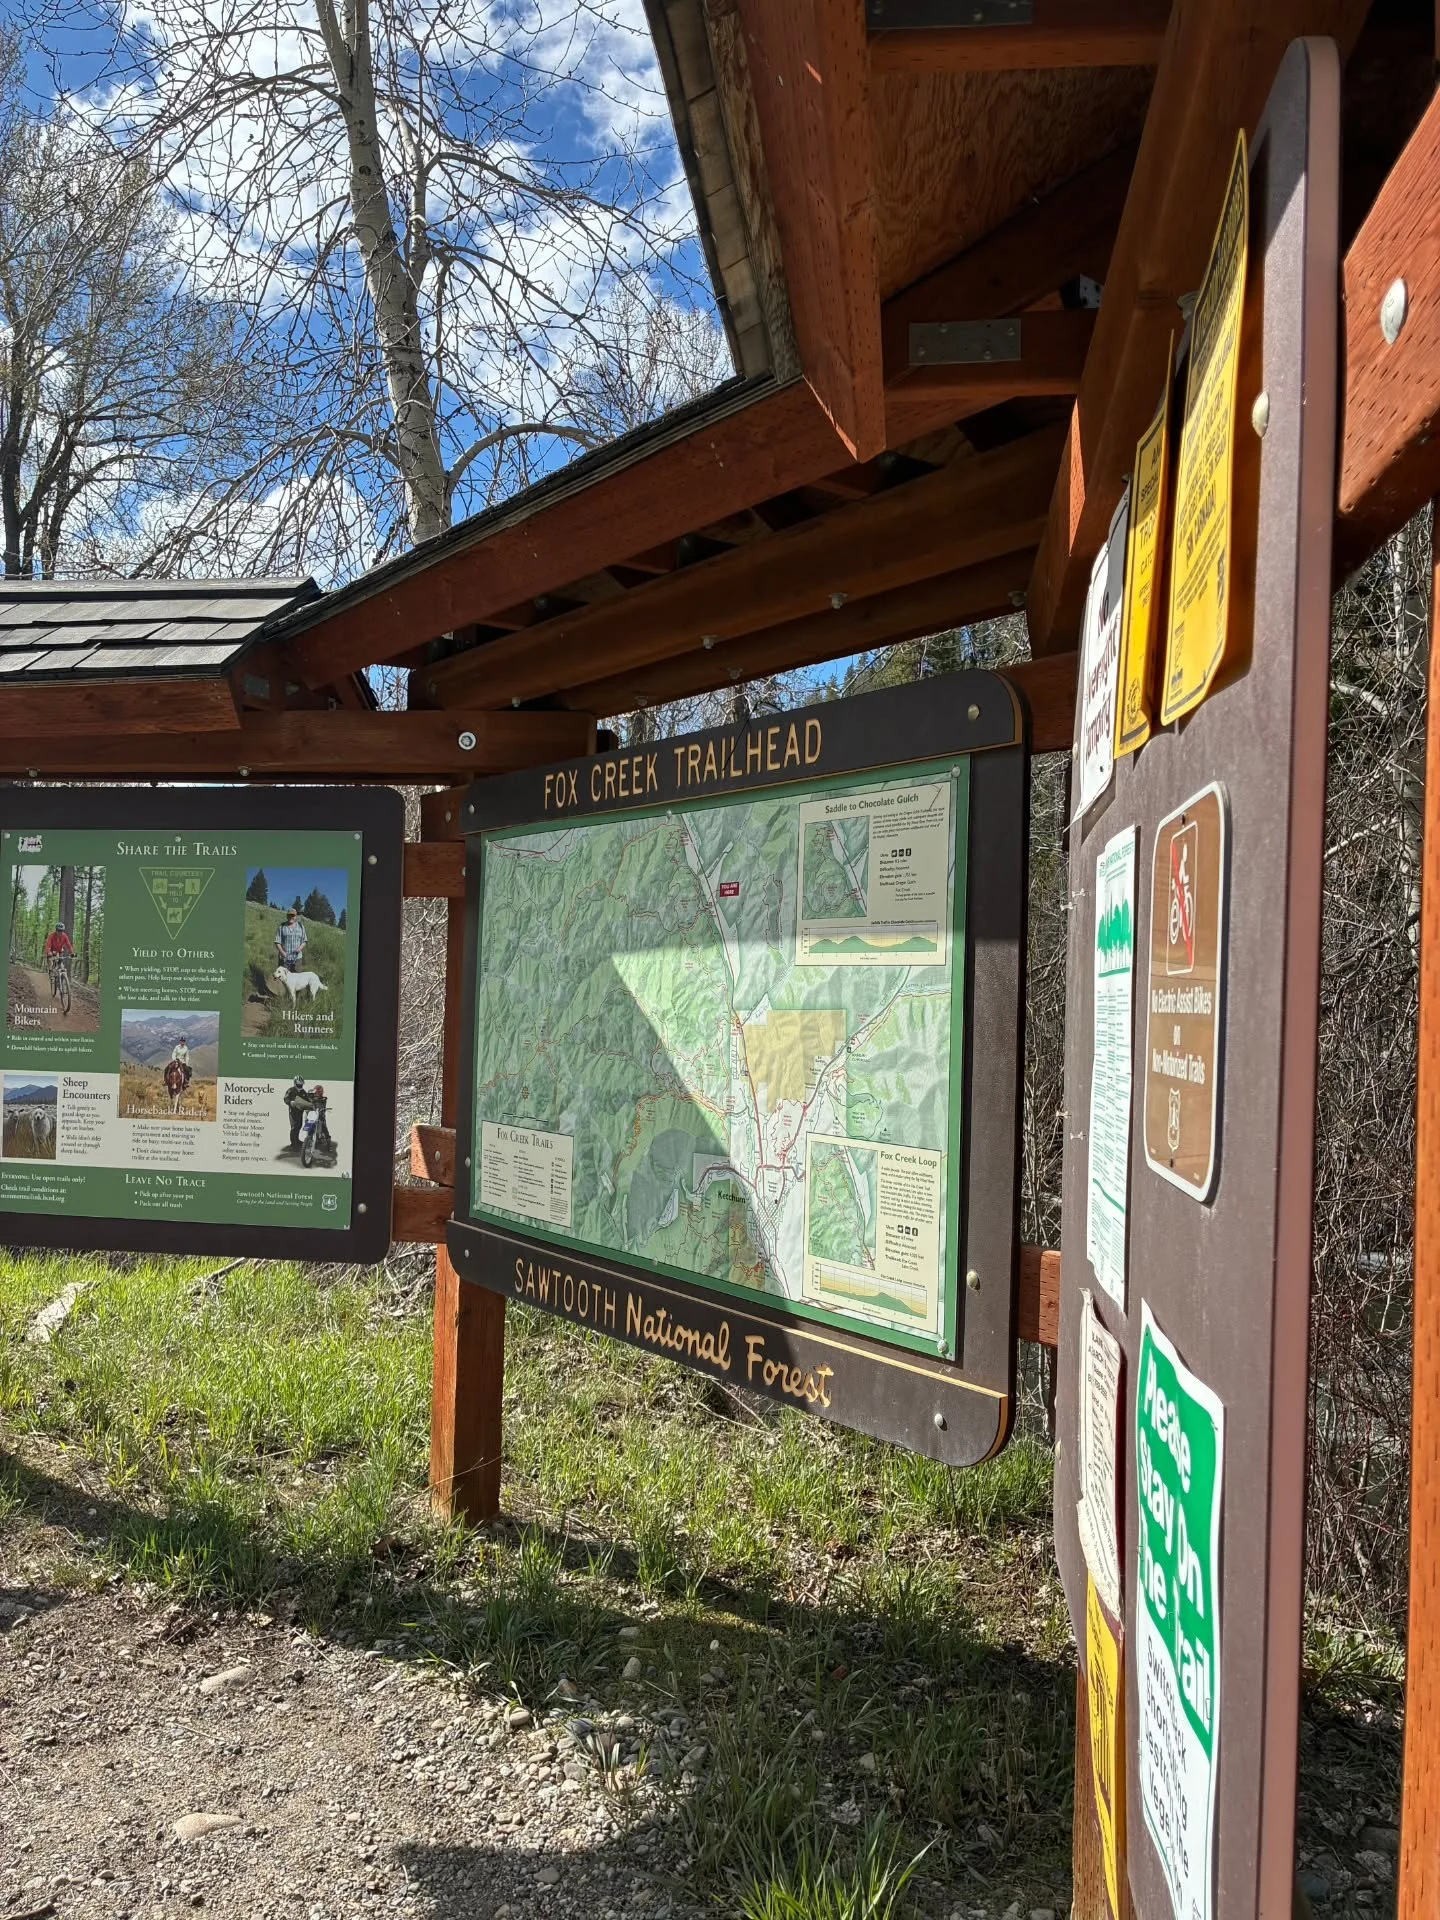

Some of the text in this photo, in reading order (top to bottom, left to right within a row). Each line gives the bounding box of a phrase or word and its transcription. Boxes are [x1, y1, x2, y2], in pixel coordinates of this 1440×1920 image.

[544, 718, 822, 810] FOX CREEK TRAILHEAD
[825, 793, 919, 815] Saddle to Chocolate Gulch
[117, 842, 237, 856] SHARE THE TRAILS
[132, 947, 215, 959] YIELD TO OTHERS
[1152, 986, 1212, 1015] No Electric Assist Bikes
[14, 1004, 58, 1014] Mountain
[282, 1010, 334, 1021] Hikers and
[14, 1015, 41, 1026] Bikers
[294, 1023, 334, 1034] Runners
[1152, 1048, 1206, 1085] Non-Motorized Trails
[62, 1077, 89, 1090] Sheep
[224, 1082, 275, 1096] Motorcycle
[62, 1089, 111, 1101] Encounters
[223, 1094, 253, 1105] Riders
[126, 1104, 207, 1117] Horseback Riders
[497, 1127, 554, 1150] FOX CREEK TRAILS
[880, 1151, 937, 1168] Fox Creek Loop
[125, 1173, 206, 1188] LEAVE NO TRACE
[236, 1190, 265, 1198] Sawtooth
[717, 1191, 746, 1204] Ketchum
[514, 1257, 834, 1408] SAWTOOTH National Forest
[1144, 1348, 1191, 1494] Please
[1140, 1426, 1204, 1619] Stay On
